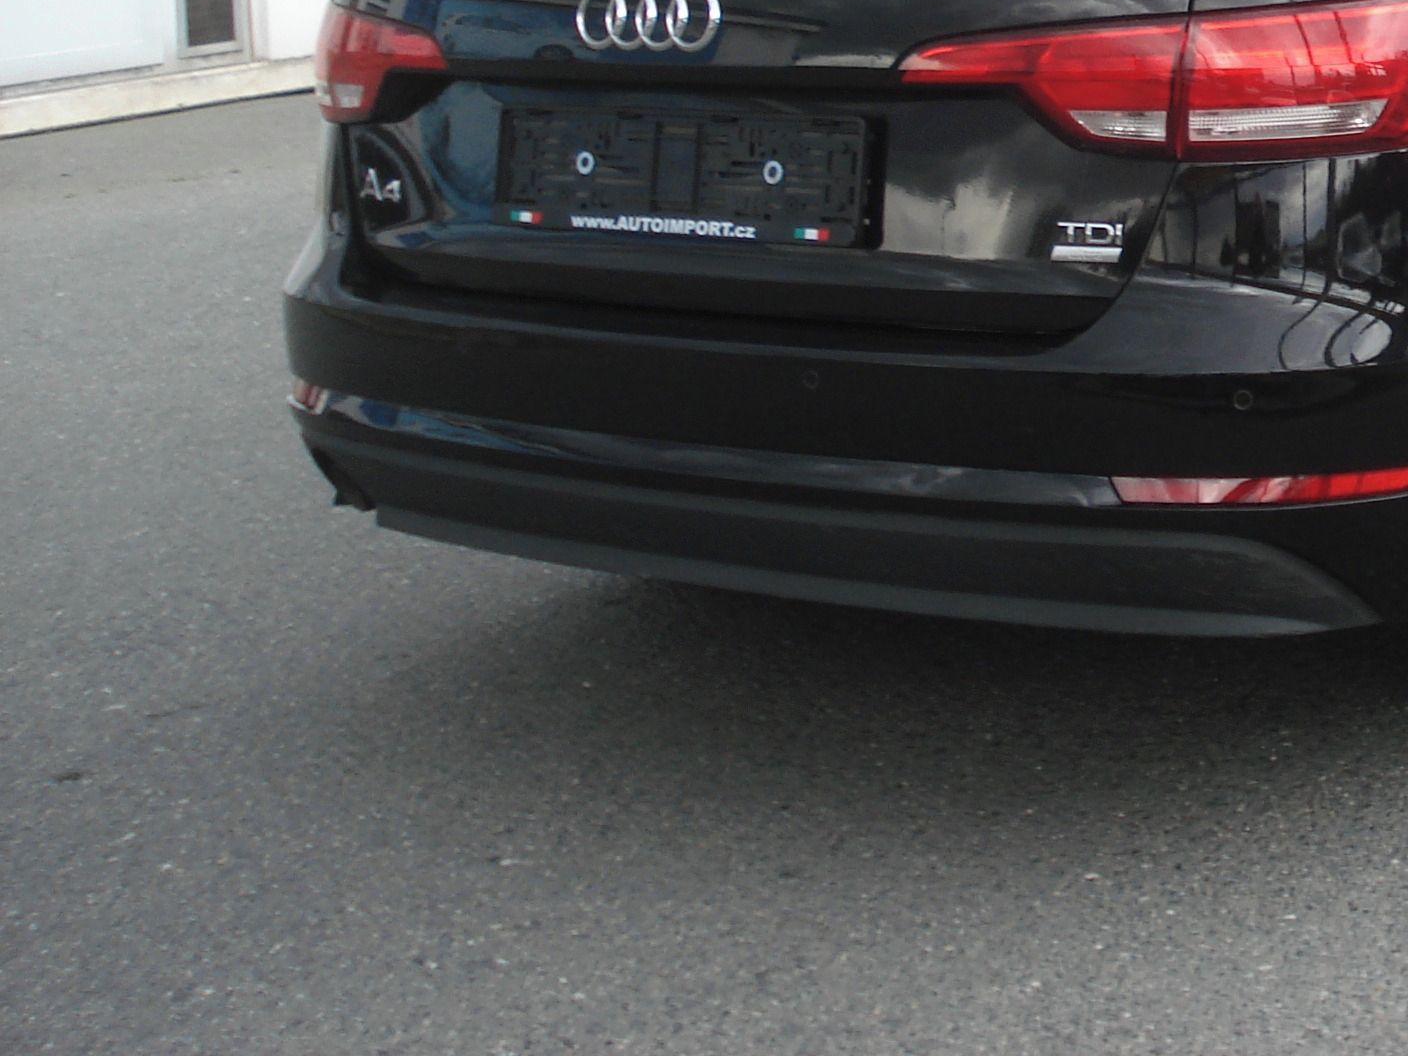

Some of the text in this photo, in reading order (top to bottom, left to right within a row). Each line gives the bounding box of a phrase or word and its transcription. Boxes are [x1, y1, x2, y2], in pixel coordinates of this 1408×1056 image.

[360, 167, 401, 203] A4
[570, 215, 756, 239] www.AUTOIMPORT.cz
[1057, 221, 1123, 245] TDI
